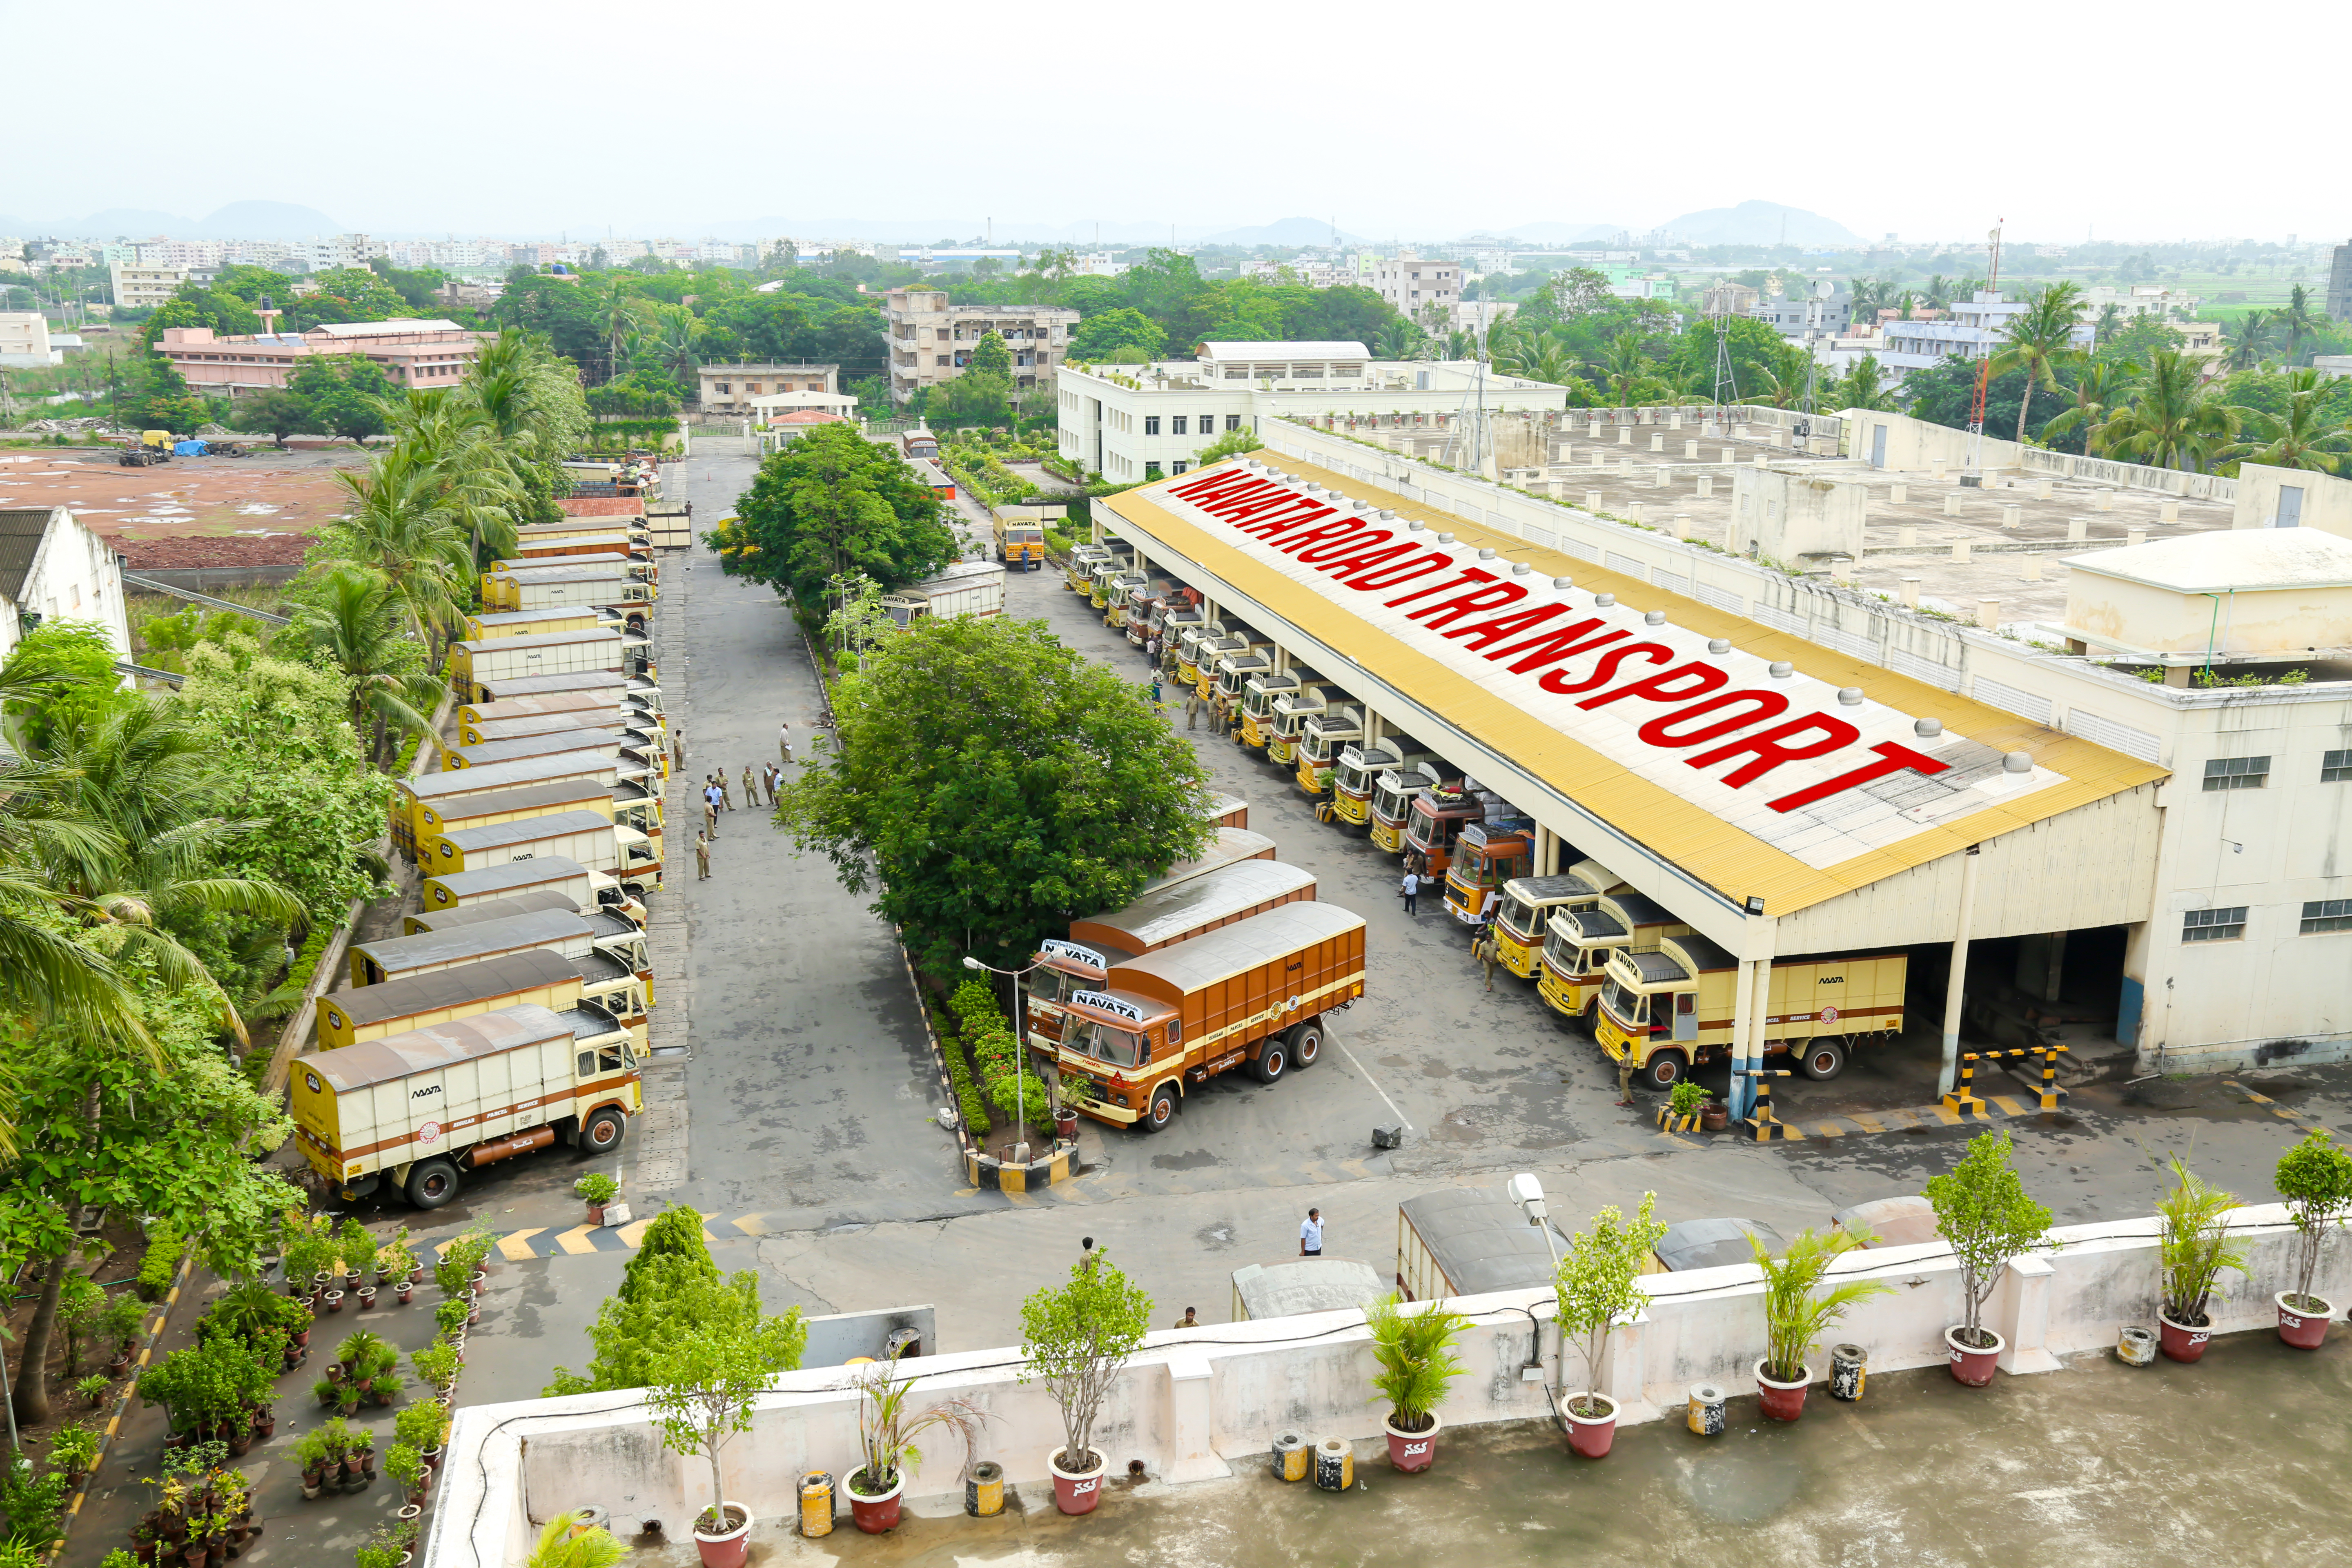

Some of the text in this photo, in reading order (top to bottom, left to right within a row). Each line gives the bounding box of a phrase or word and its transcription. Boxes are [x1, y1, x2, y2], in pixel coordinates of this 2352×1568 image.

[1167, 468, 1951, 813] NAVATA ROAD TRANSPORT
[1281, 693, 1290, 705] NAVATA
[1346, 747, 1362, 762] NAVATA
[1384, 769, 1398, 785] NAVATA
[1558, 908, 1579, 933] NAVATA
[1045, 944, 1099, 967] NVATA
[1615, 951, 1637, 979] NAVATA
[1077, 995, 1136, 1020] NAVATA
[1208, 1013, 1264, 1041] REGULAR PARCEL SERVICE
[453, 1100, 539, 1128] REGULAR PARCEL SERVICE
[420, 1123, 438, 1133] NAVATA
